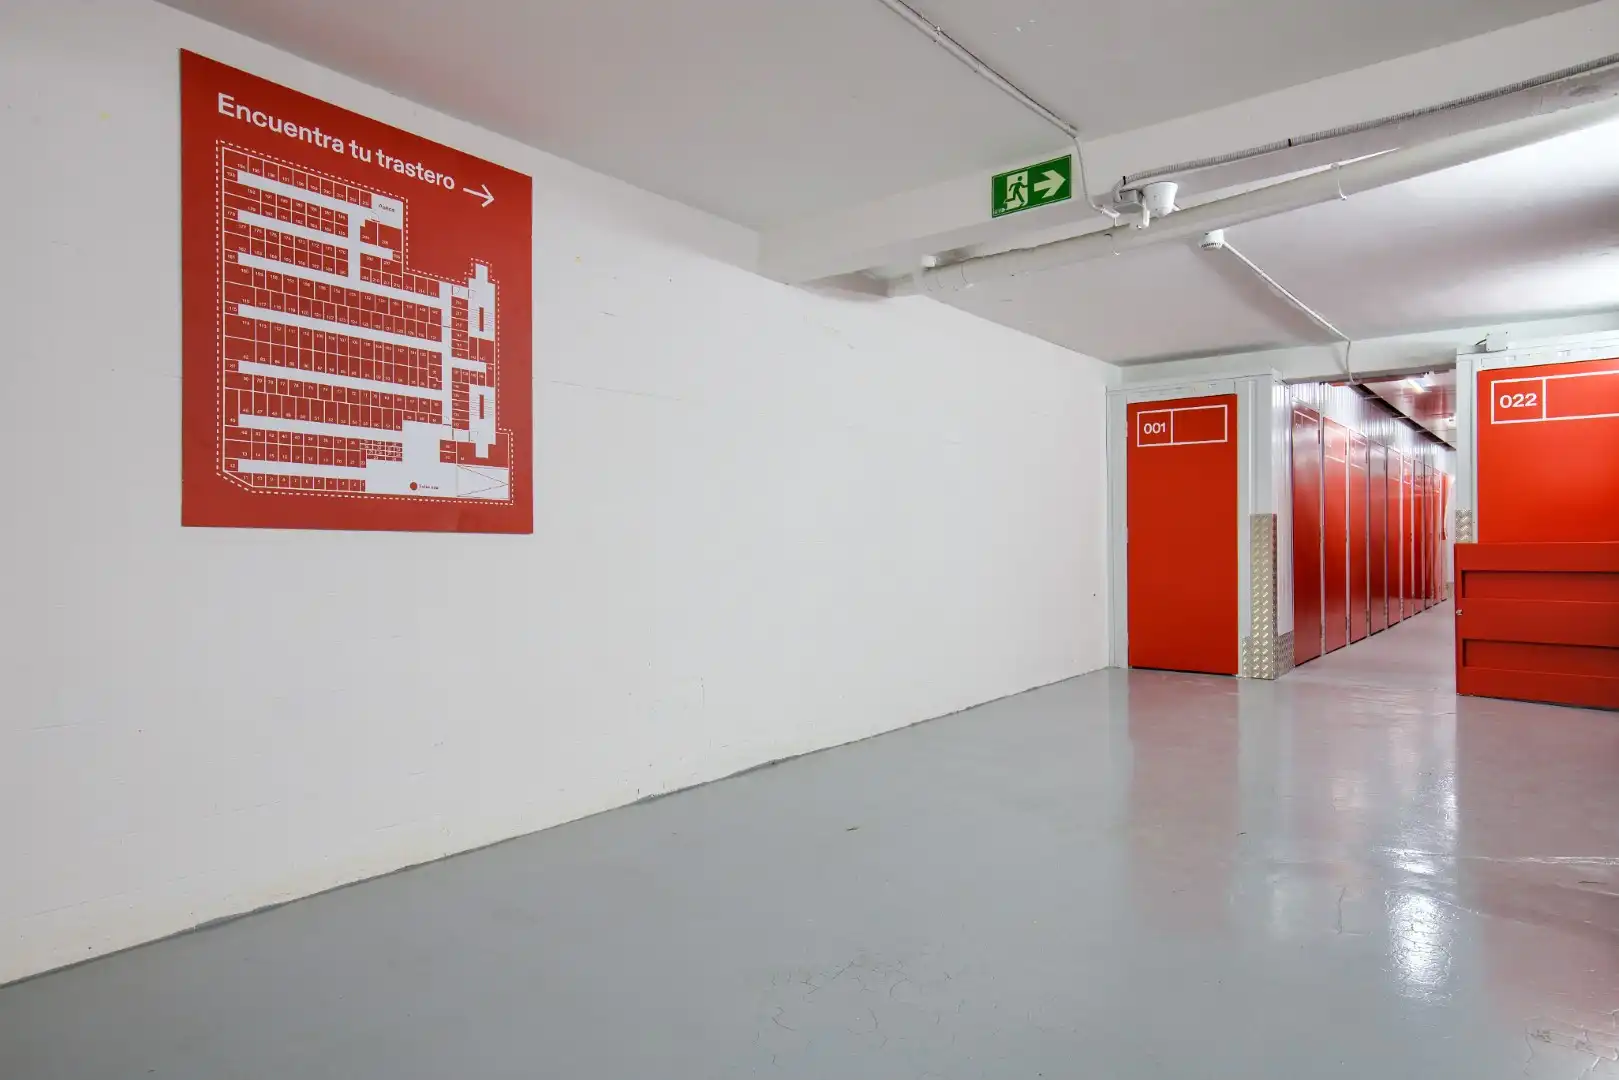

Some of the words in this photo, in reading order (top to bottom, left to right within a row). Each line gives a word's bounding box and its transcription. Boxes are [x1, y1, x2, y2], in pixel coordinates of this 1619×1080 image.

[217, 92, 344, 154] Encuentra
[348, 139, 371, 163] tu
[375, 148, 456, 191] trastero
[1499, 393, 1538, 409] 022
[1143, 422, 1166, 435] 001
